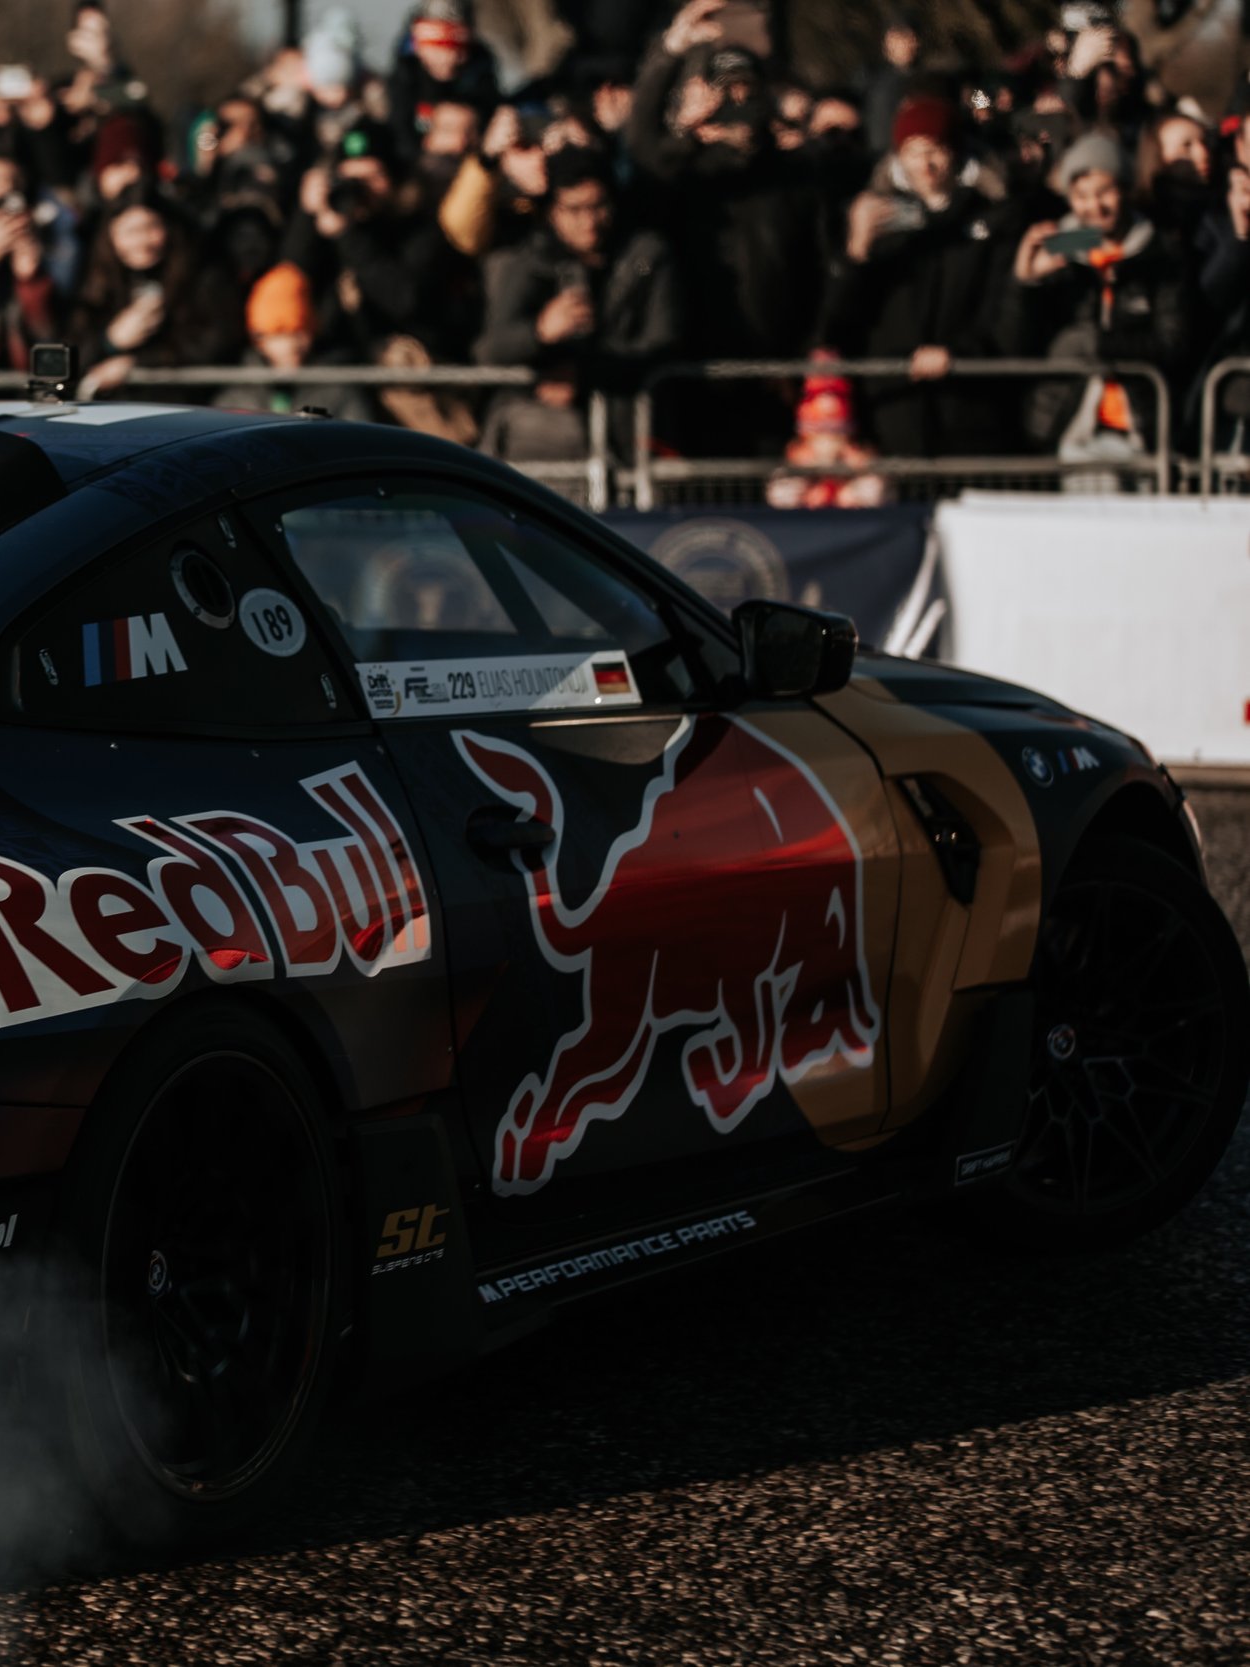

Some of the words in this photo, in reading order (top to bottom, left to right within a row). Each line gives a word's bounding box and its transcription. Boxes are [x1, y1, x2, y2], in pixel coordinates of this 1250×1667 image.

[250, 603, 294, 645] 189
[448, 671, 477, 700] 229
[477, 669, 513, 699] ELIAS
[674, 1210, 758, 1247] PARTS
